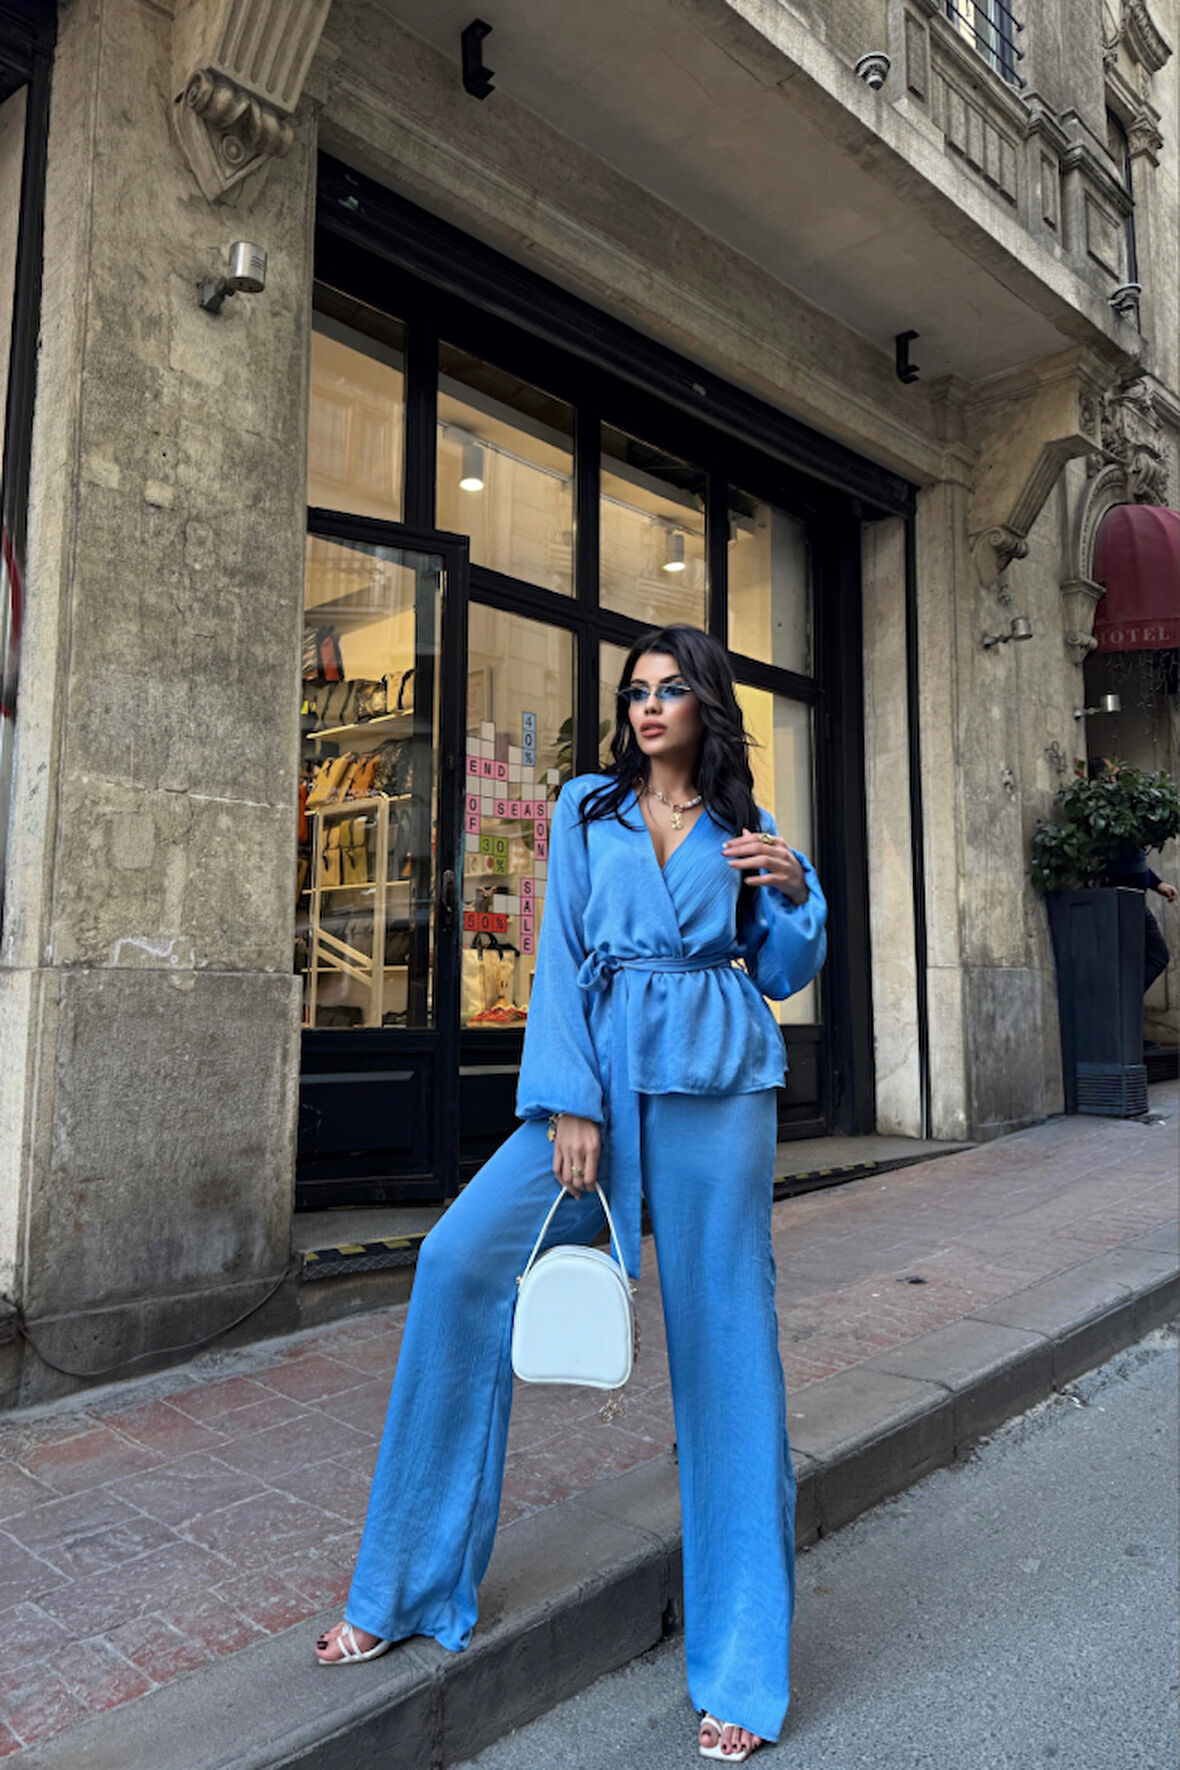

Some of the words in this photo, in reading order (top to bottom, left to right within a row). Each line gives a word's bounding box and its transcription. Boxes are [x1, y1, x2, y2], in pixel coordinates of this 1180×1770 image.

[524, 716, 533, 763] 40%
[470, 760, 505, 777] END
[467, 914, 504, 930] 50%
[523, 881, 531, 951] SALE
